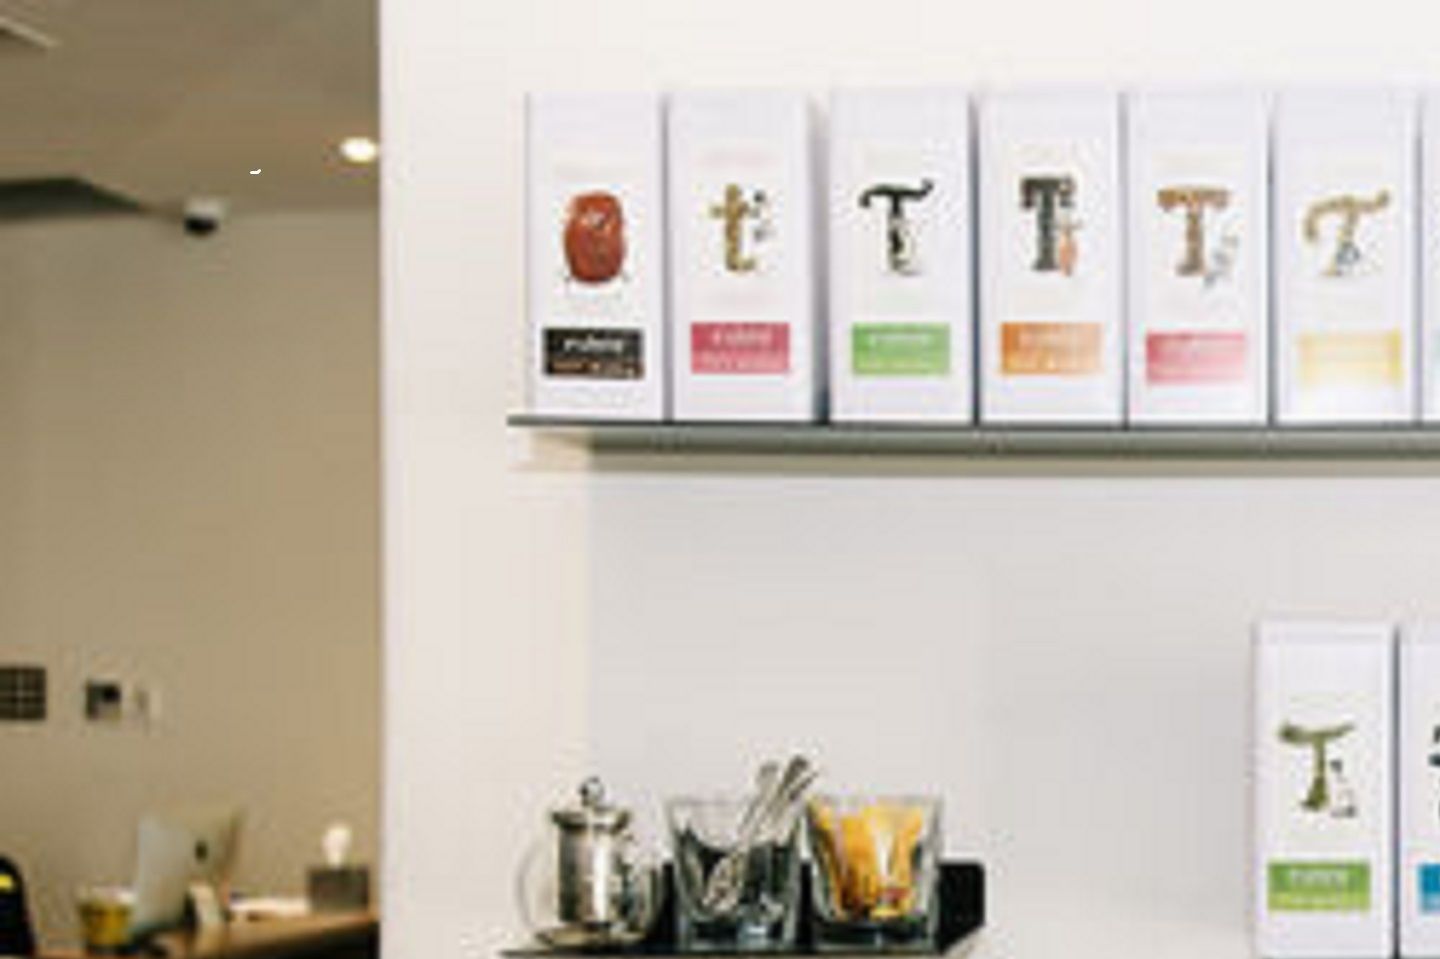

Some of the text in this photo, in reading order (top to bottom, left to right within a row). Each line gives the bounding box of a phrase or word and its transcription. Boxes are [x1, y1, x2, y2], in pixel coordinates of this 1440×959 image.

[858, 179, 934, 275] T
[1019, 175, 1076, 275] T
[1156, 186, 1229, 276] T
[1276, 723, 1356, 813] T
